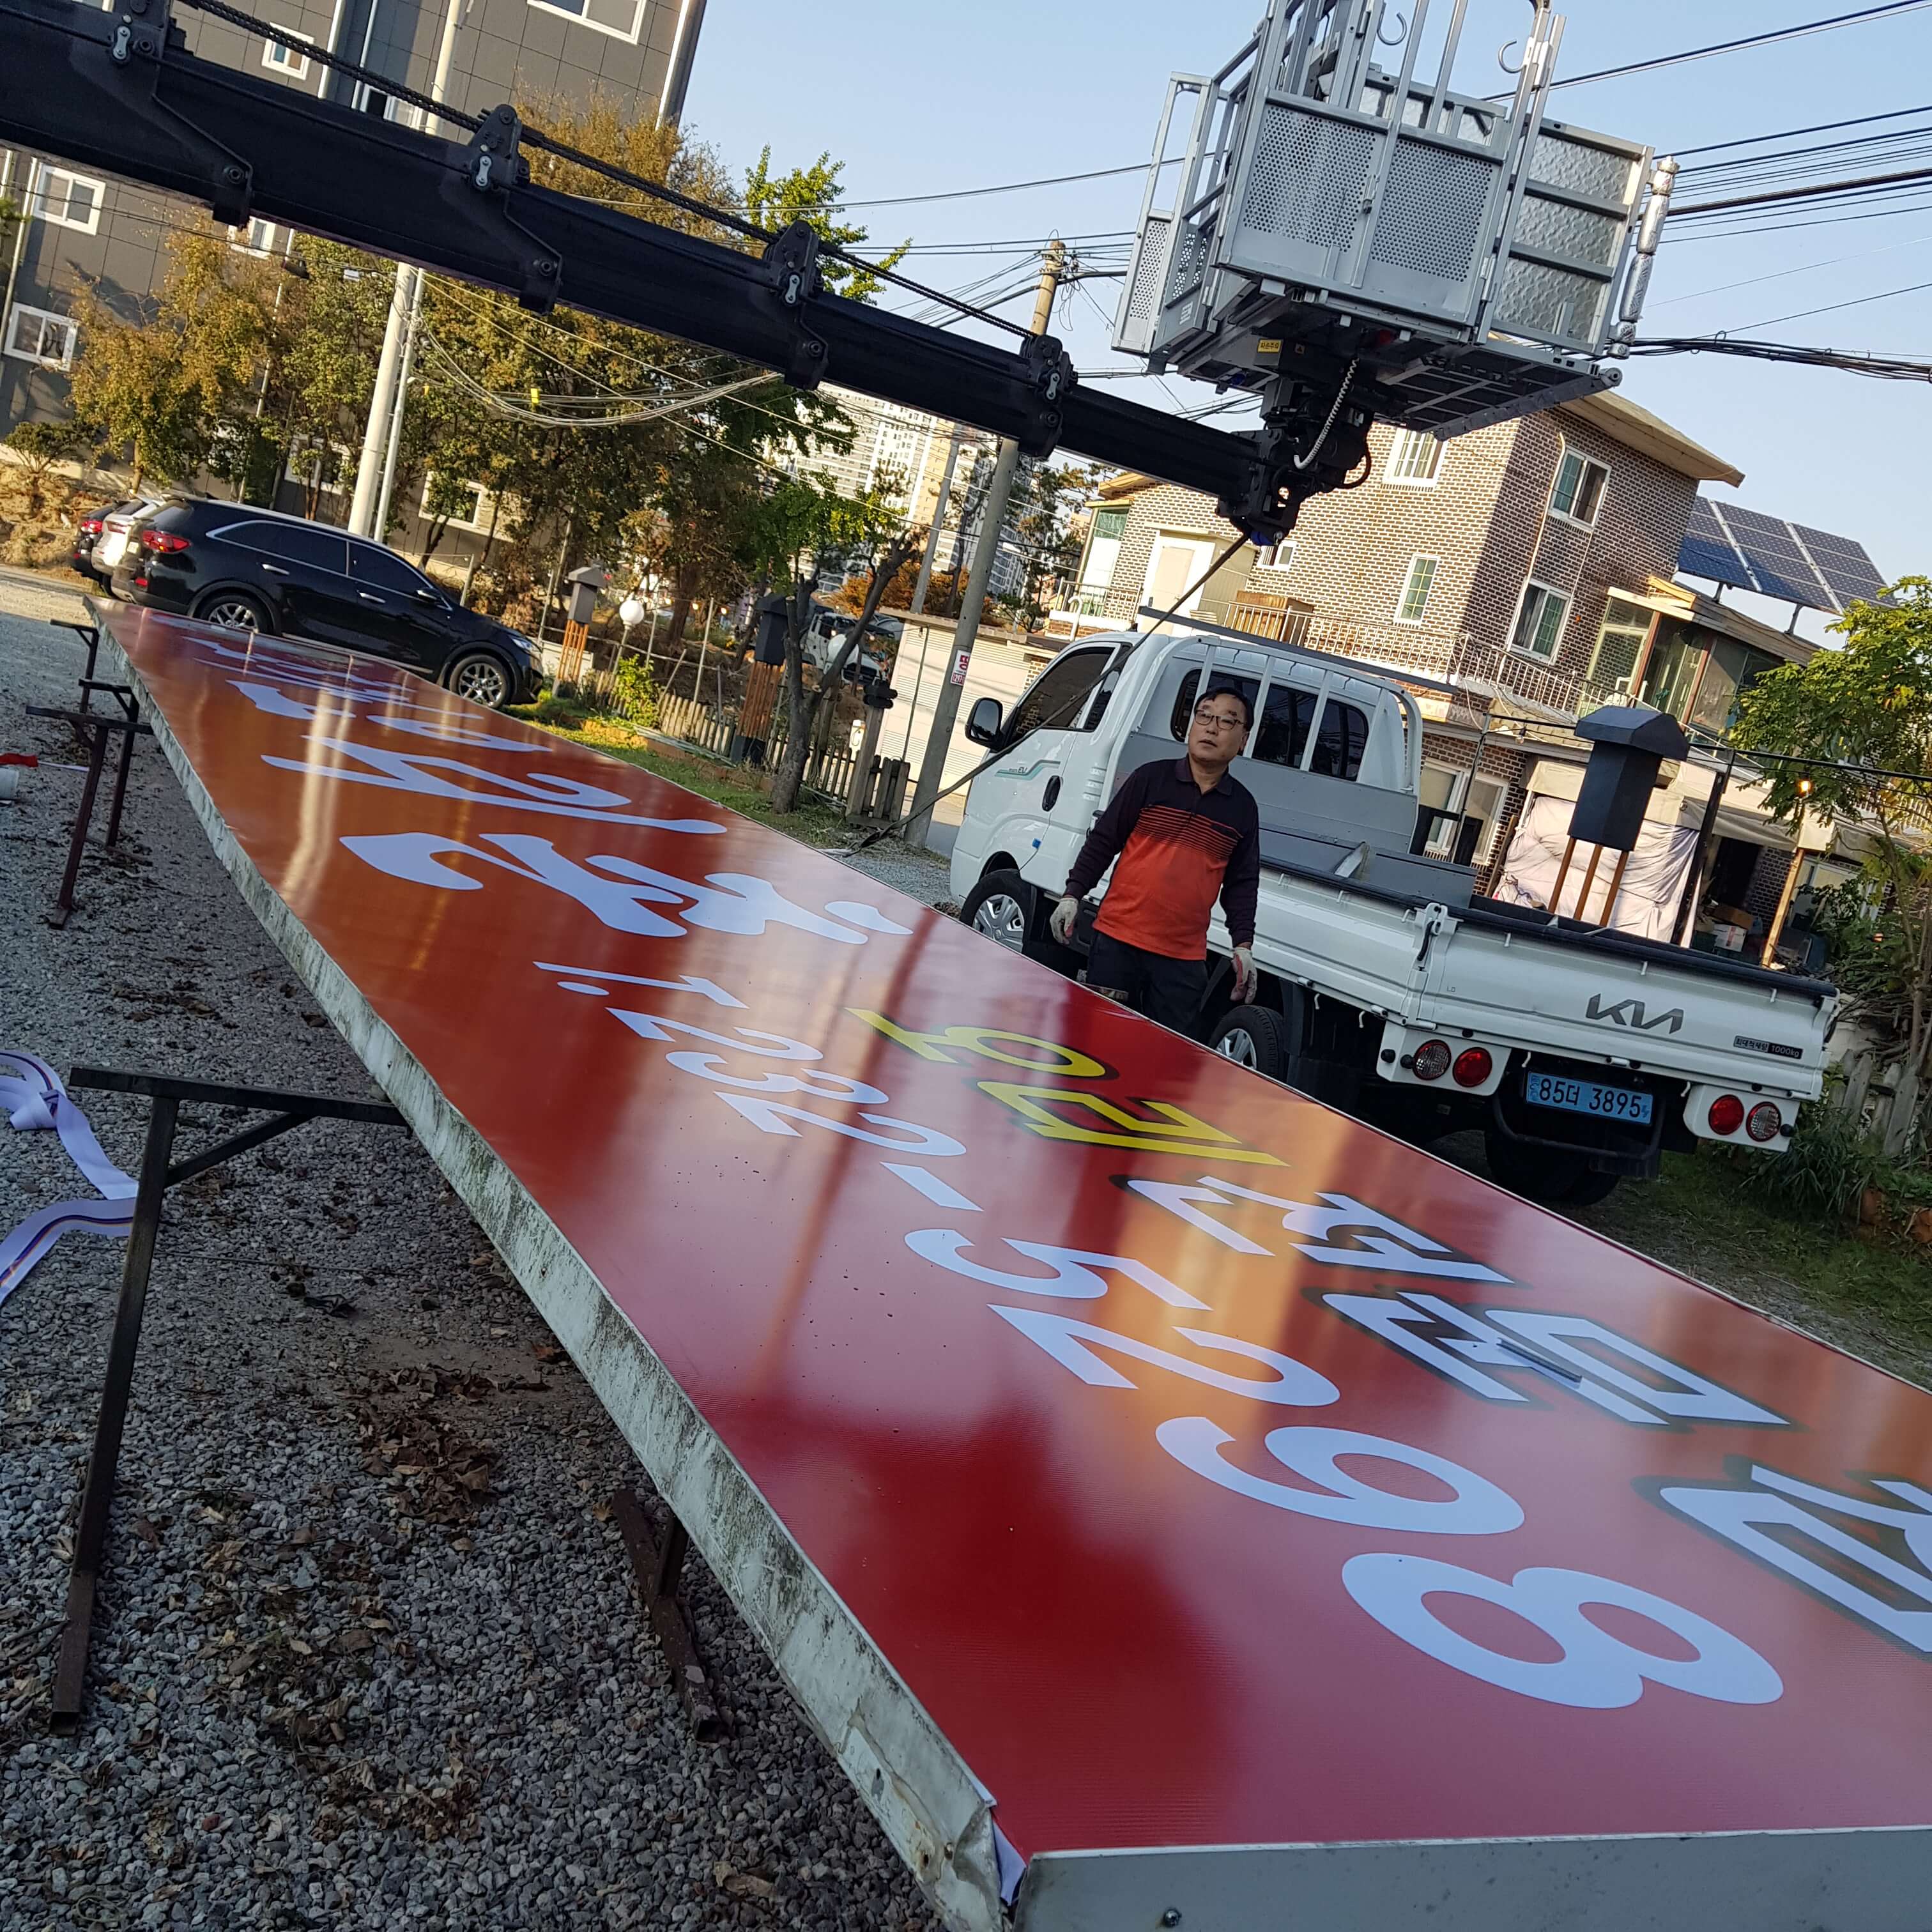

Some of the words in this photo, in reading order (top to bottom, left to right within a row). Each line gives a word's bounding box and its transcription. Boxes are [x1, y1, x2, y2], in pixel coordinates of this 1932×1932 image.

[1586, 993, 1685, 1034] KIA
[1771, 1045, 1800, 1058] 1000kg
[1539, 1078, 1581, 1105] 85더
[1589, 1087, 1642, 1118] 3895
